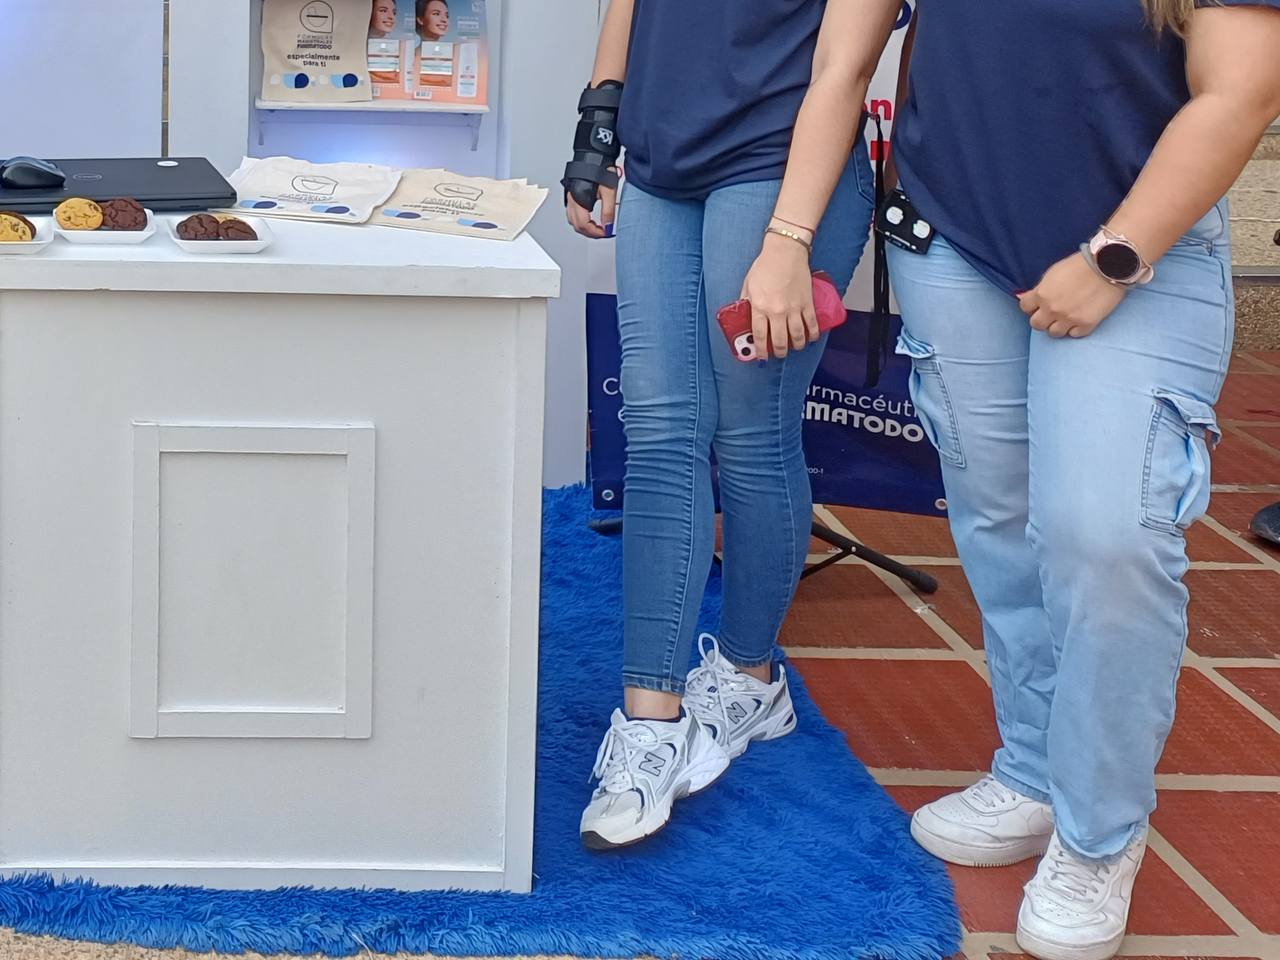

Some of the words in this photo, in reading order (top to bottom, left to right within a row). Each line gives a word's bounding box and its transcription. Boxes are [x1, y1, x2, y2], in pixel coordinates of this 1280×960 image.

[287, 53, 341, 61] especialmente
[806, 384, 918, 418] rmacéut
[801, 400, 924, 442] MATODO
